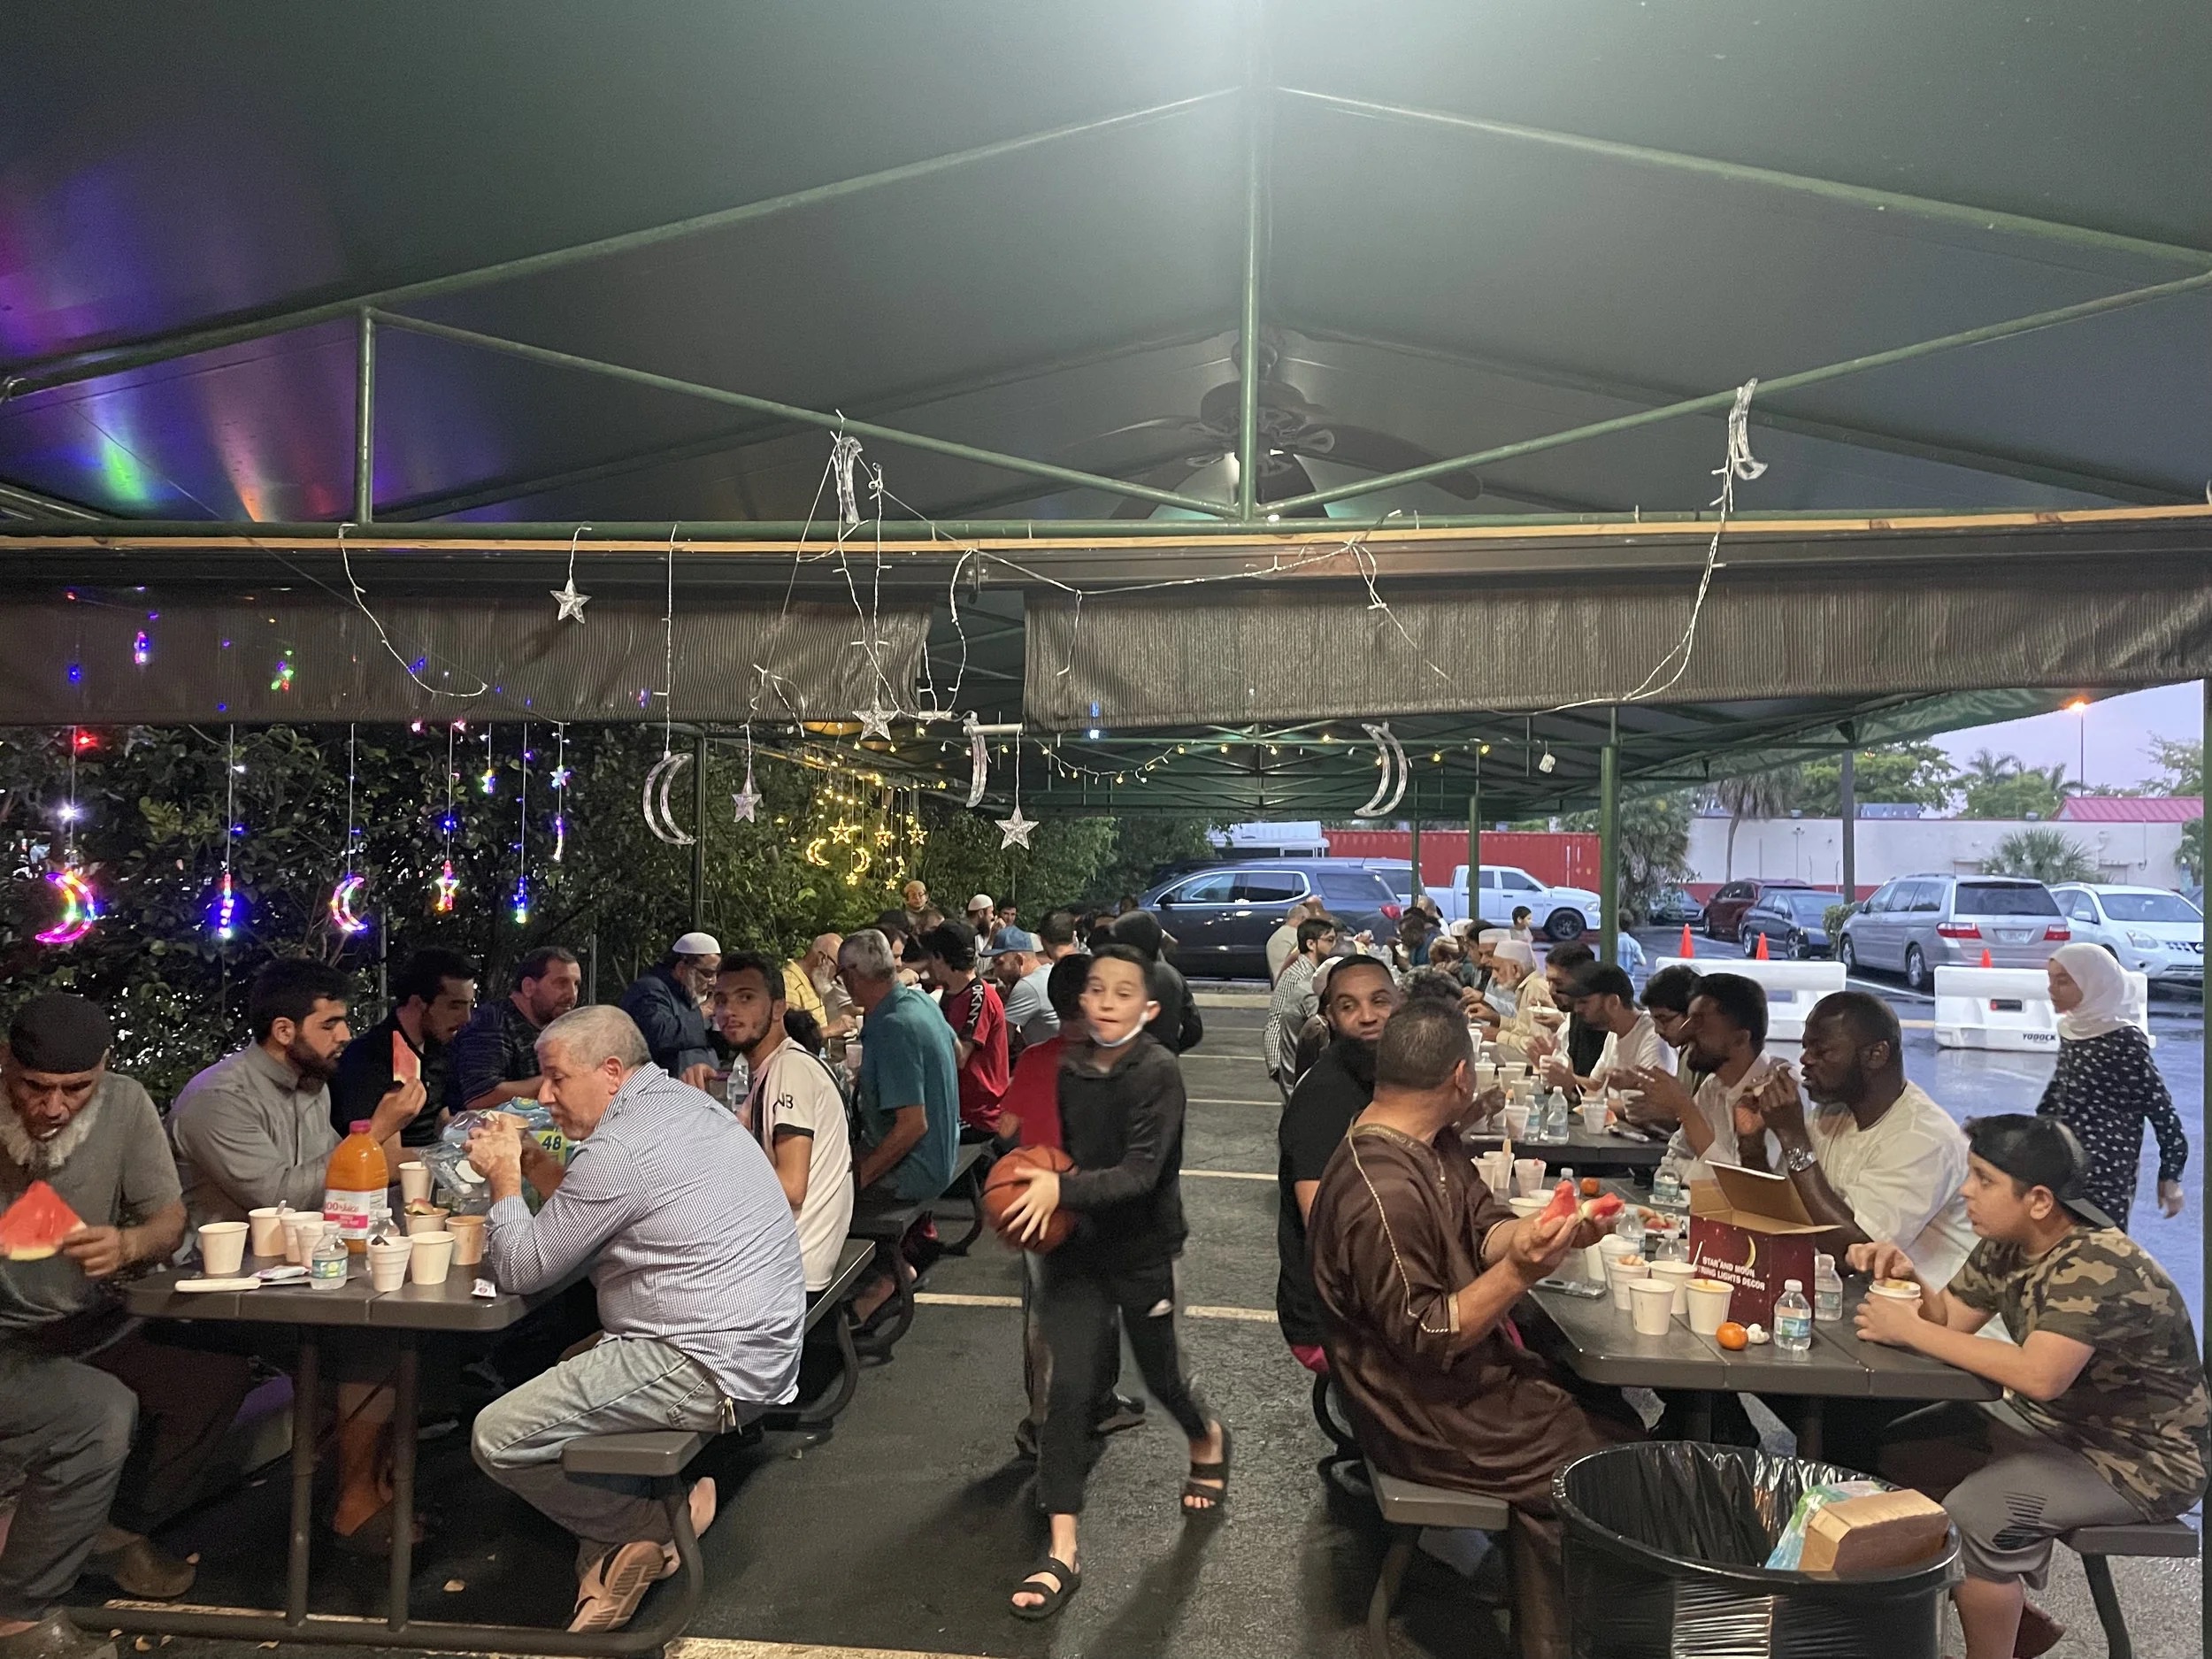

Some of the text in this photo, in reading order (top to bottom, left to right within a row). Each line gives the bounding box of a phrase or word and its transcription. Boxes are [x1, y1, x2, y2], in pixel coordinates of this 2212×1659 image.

[541, 1135, 562, 1150] 48
[1697, 1265, 1766, 1291] TRING LIGHTS DECOR
[1702, 1256, 1755, 1278] STAR AND MOON
